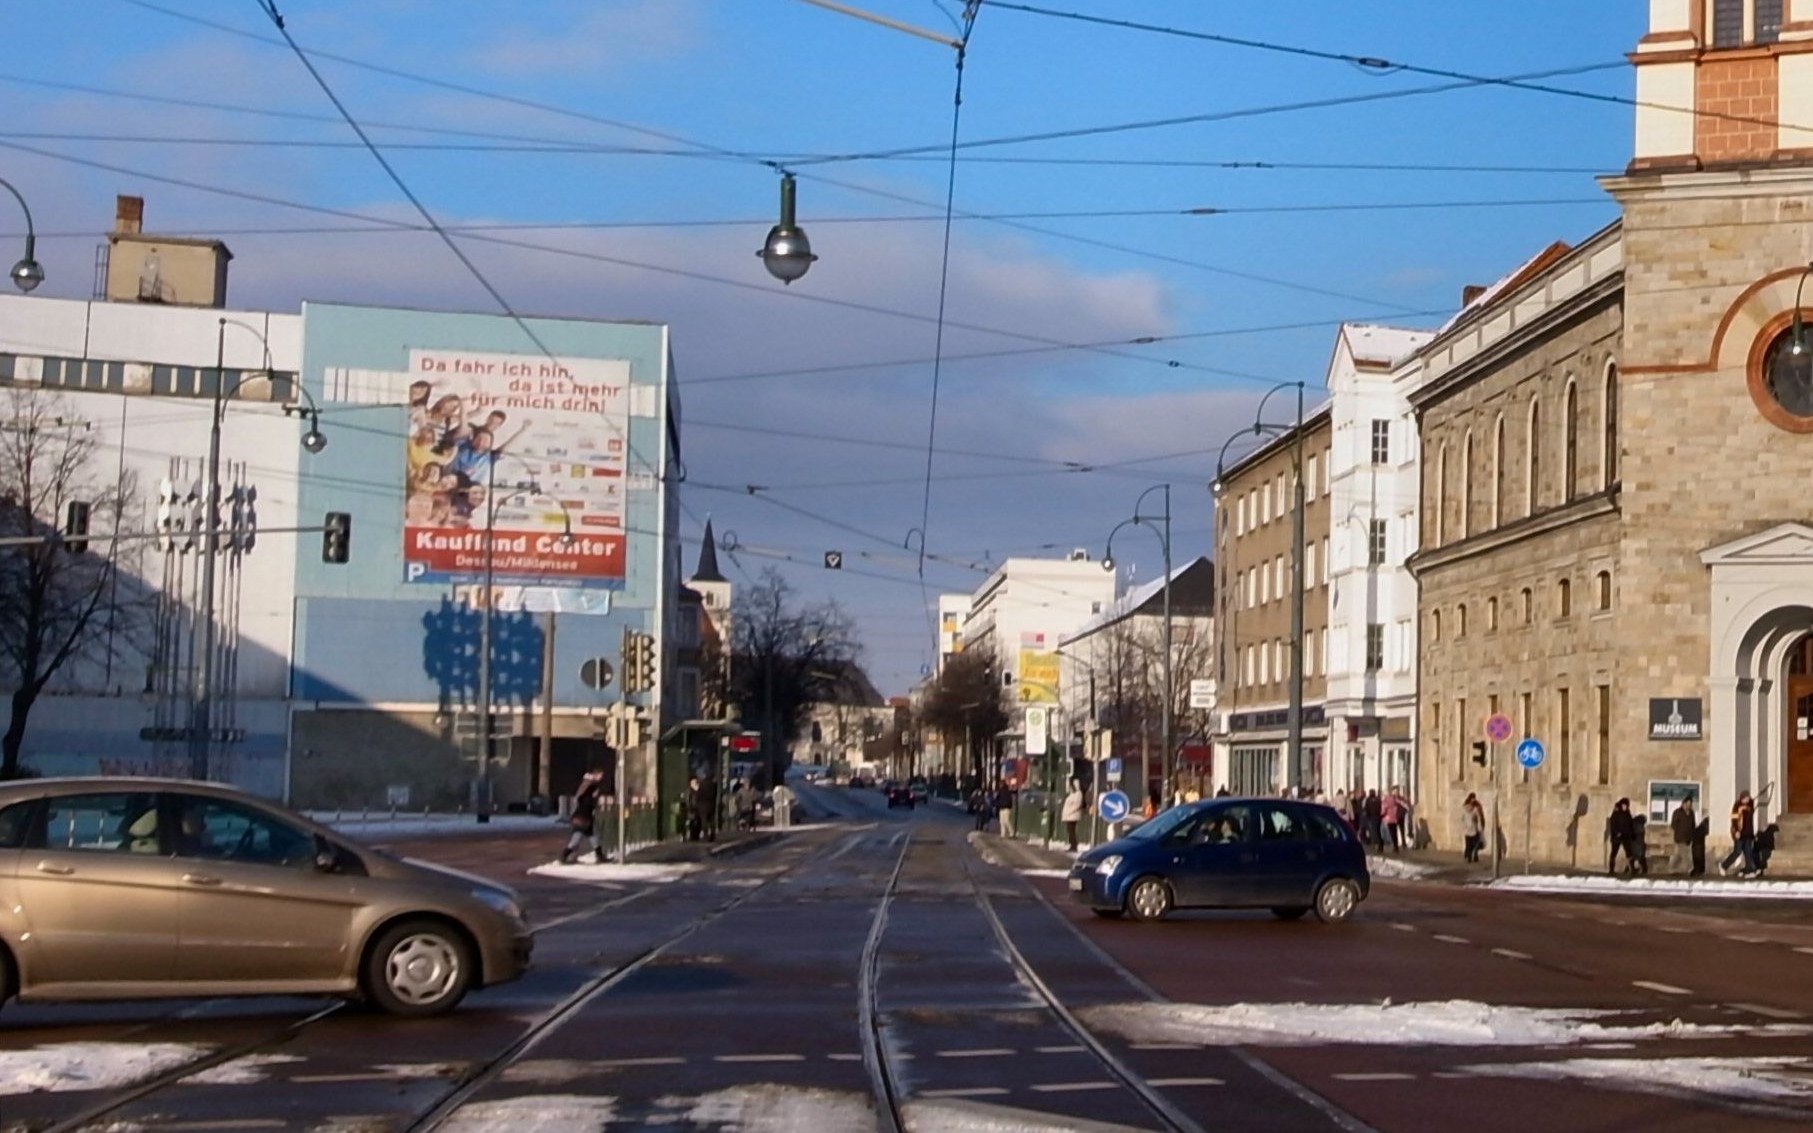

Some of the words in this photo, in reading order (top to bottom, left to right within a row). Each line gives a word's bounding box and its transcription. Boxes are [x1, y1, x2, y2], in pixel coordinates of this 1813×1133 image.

[421, 357, 446, 372] Da
[454, 359, 494, 374] fahr
[503, 361, 532, 376] ich
[509, 379, 532, 393] da
[540, 380, 565, 395] ist
[572, 383, 620, 398] mehr
[471, 392, 502, 407] für
[507, 395, 554, 410] mich
[1652, 722, 1699, 735] MUSEUM
